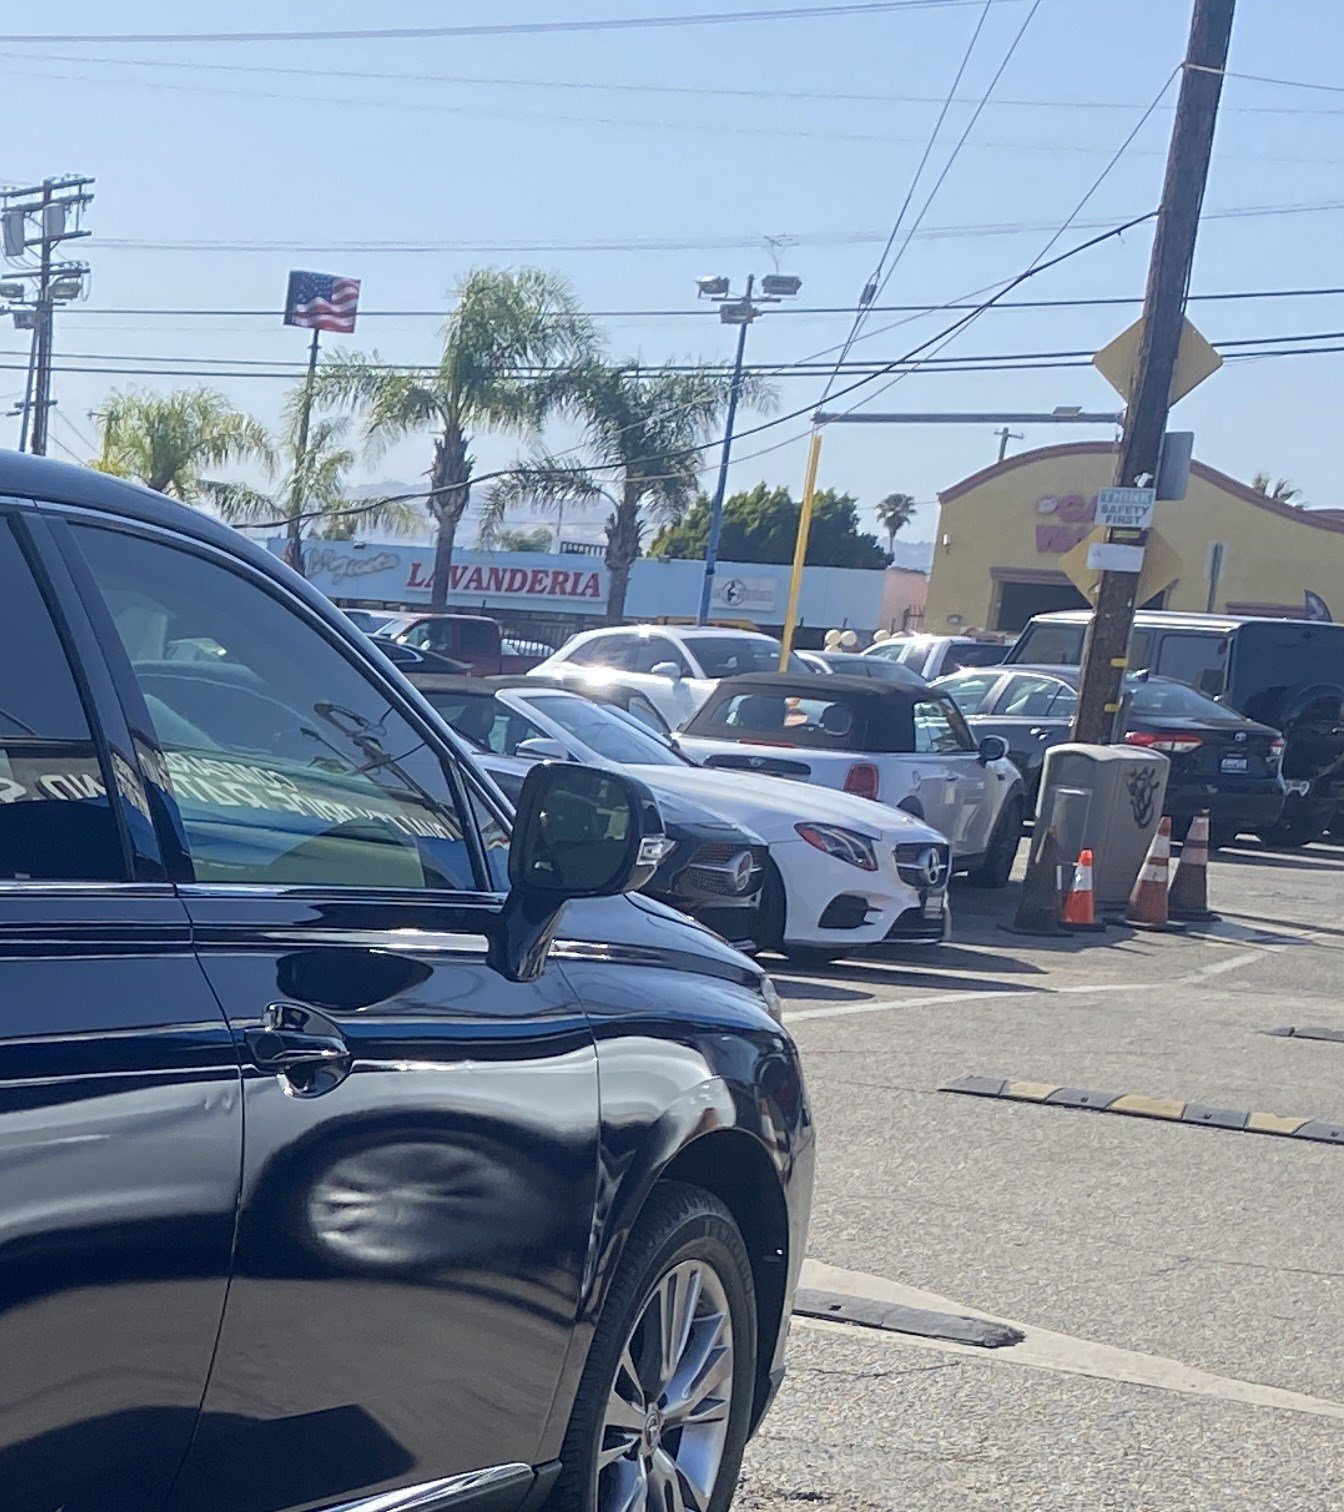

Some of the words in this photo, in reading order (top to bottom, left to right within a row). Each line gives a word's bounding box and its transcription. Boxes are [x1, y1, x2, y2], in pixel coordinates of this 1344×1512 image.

[1101, 490, 1152, 503] THINK
[1100, 504, 1150, 515] SAFETY
[1105, 514, 1142, 525] FIRST
